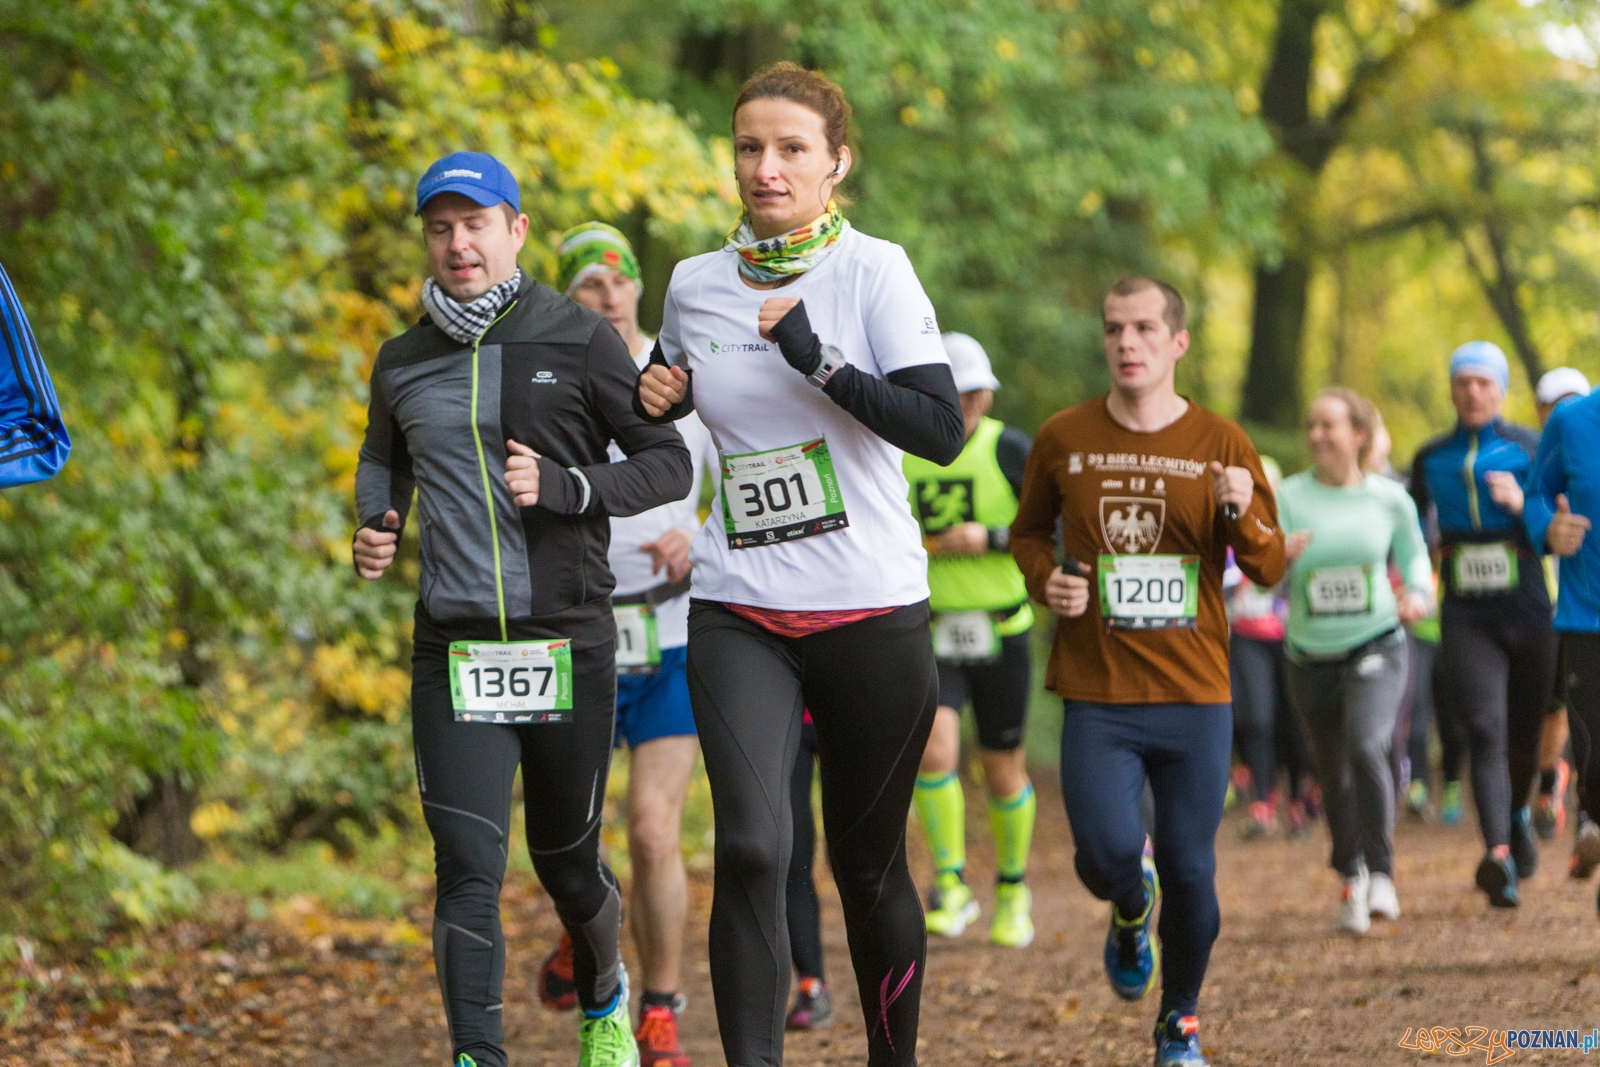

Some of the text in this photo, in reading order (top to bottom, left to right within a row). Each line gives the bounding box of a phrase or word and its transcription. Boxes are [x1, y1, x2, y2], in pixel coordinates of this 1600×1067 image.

[1106, 453, 1138, 465] BIEG
[739, 472, 809, 517] 301
[755, 512, 807, 529] KATARZYNA
[1113, 578, 1183, 603] 1200
[616, 628, 632, 651] 1
[469, 667, 553, 697] 1367
